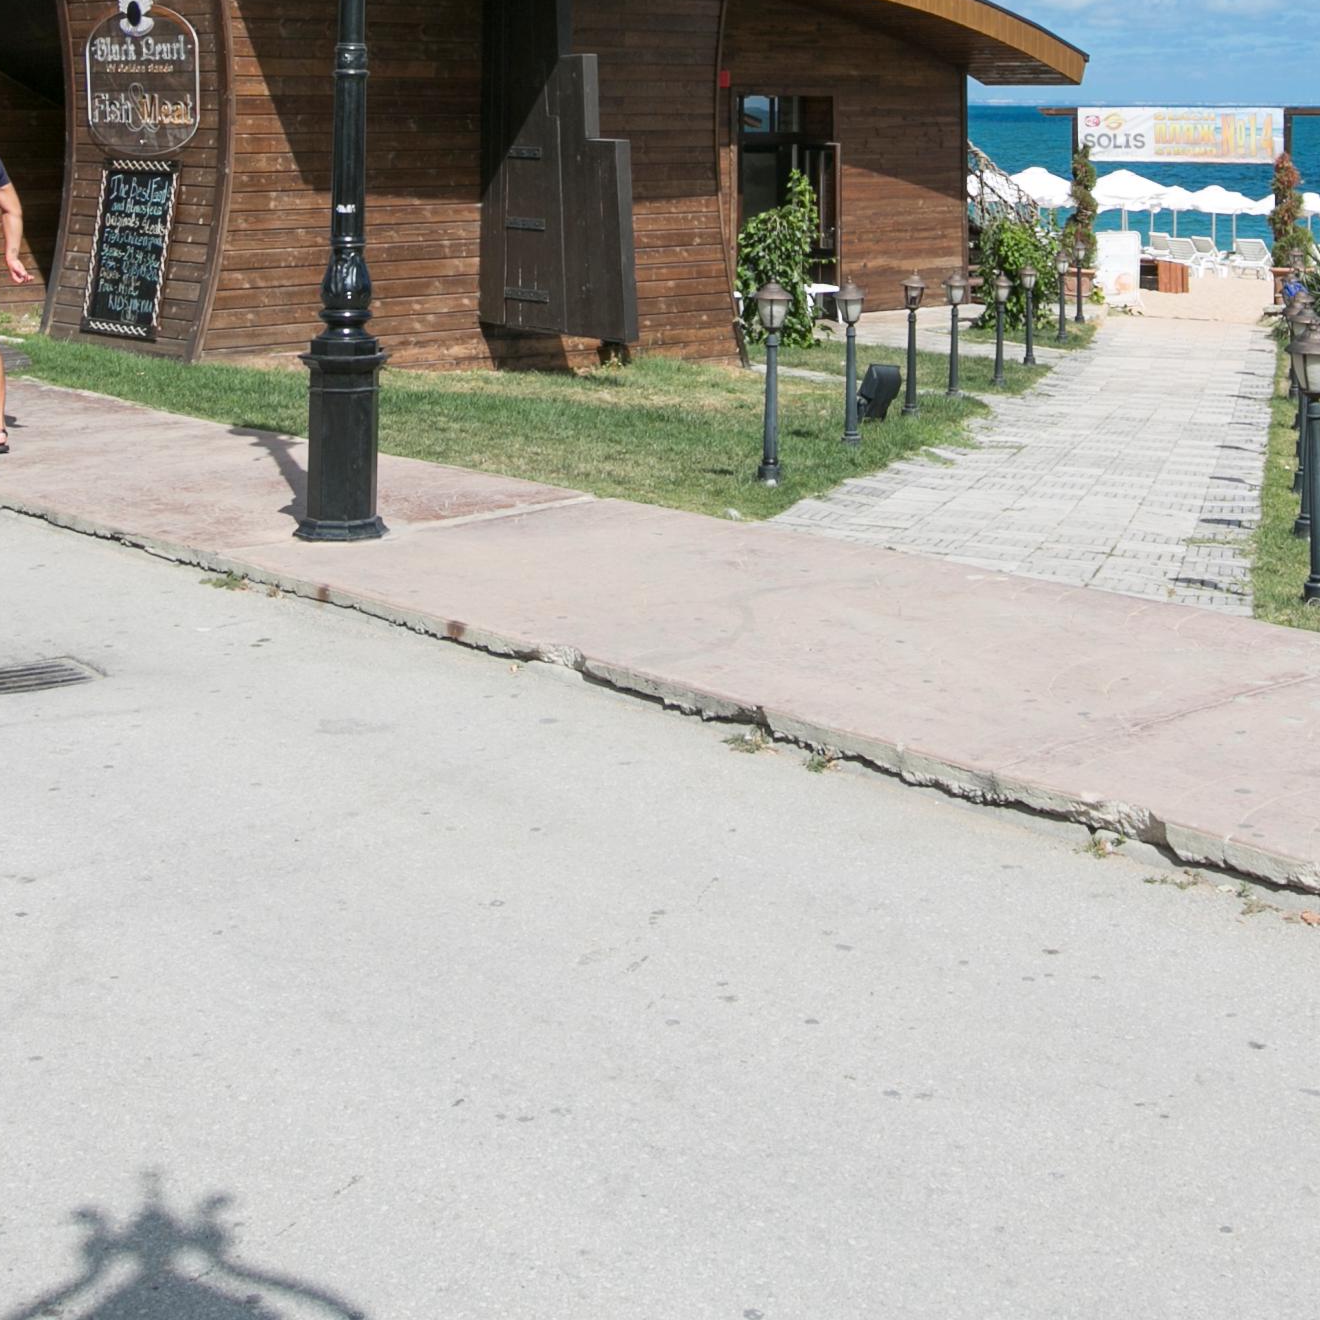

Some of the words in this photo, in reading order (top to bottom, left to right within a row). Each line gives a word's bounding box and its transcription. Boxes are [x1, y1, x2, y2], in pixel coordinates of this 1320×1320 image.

[93, 37, 136, 61] Black
[140, 35, 185, 60] Pearl
[93, 93, 132, 123] Fish
[140, 93, 194, 125] Meat
[1083, 133, 1146, 150] SOLIS
